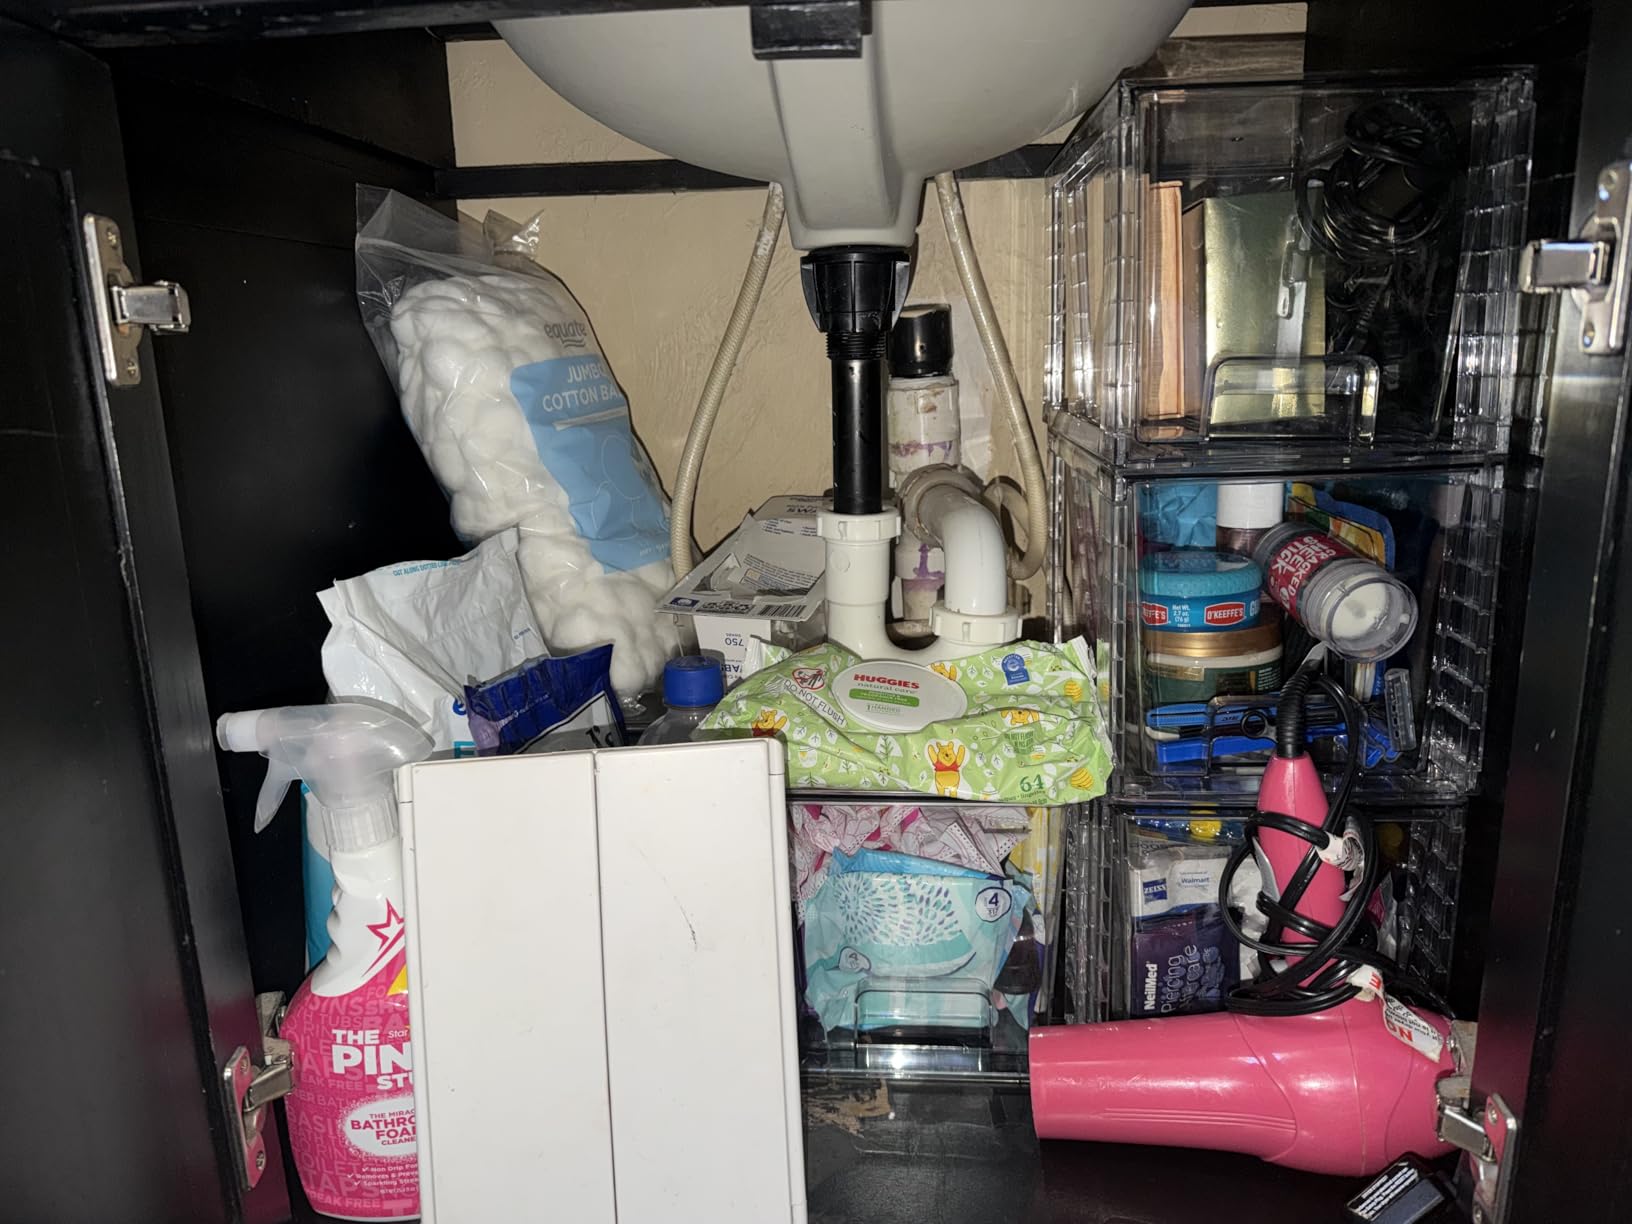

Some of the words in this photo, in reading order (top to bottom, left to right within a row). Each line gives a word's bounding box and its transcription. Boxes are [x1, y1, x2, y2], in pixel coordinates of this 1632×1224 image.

[544, 321, 587, 342] equate
[542, 386, 599, 412] COTTON
[1207, 607, 1244, 620] O'KEEFFE'S
[724, 637, 744, 647] 750
[853, 673, 920, 690] HUGGIES
[857, 682, 894, 692] natural
[784, 680, 798, 692] DO
[799, 689, 819, 705] NOT
[1020, 773, 1044, 793] 64
[1144, 885, 1166, 894] ZEISS
[988, 892, 999, 907] 4
[1144, 962, 1158, 1011] NeilMed
[1161, 954, 1185, 1013] Piercing
[332, 1029, 379, 1045] THE
[332, 1041, 412, 1075] PIN
